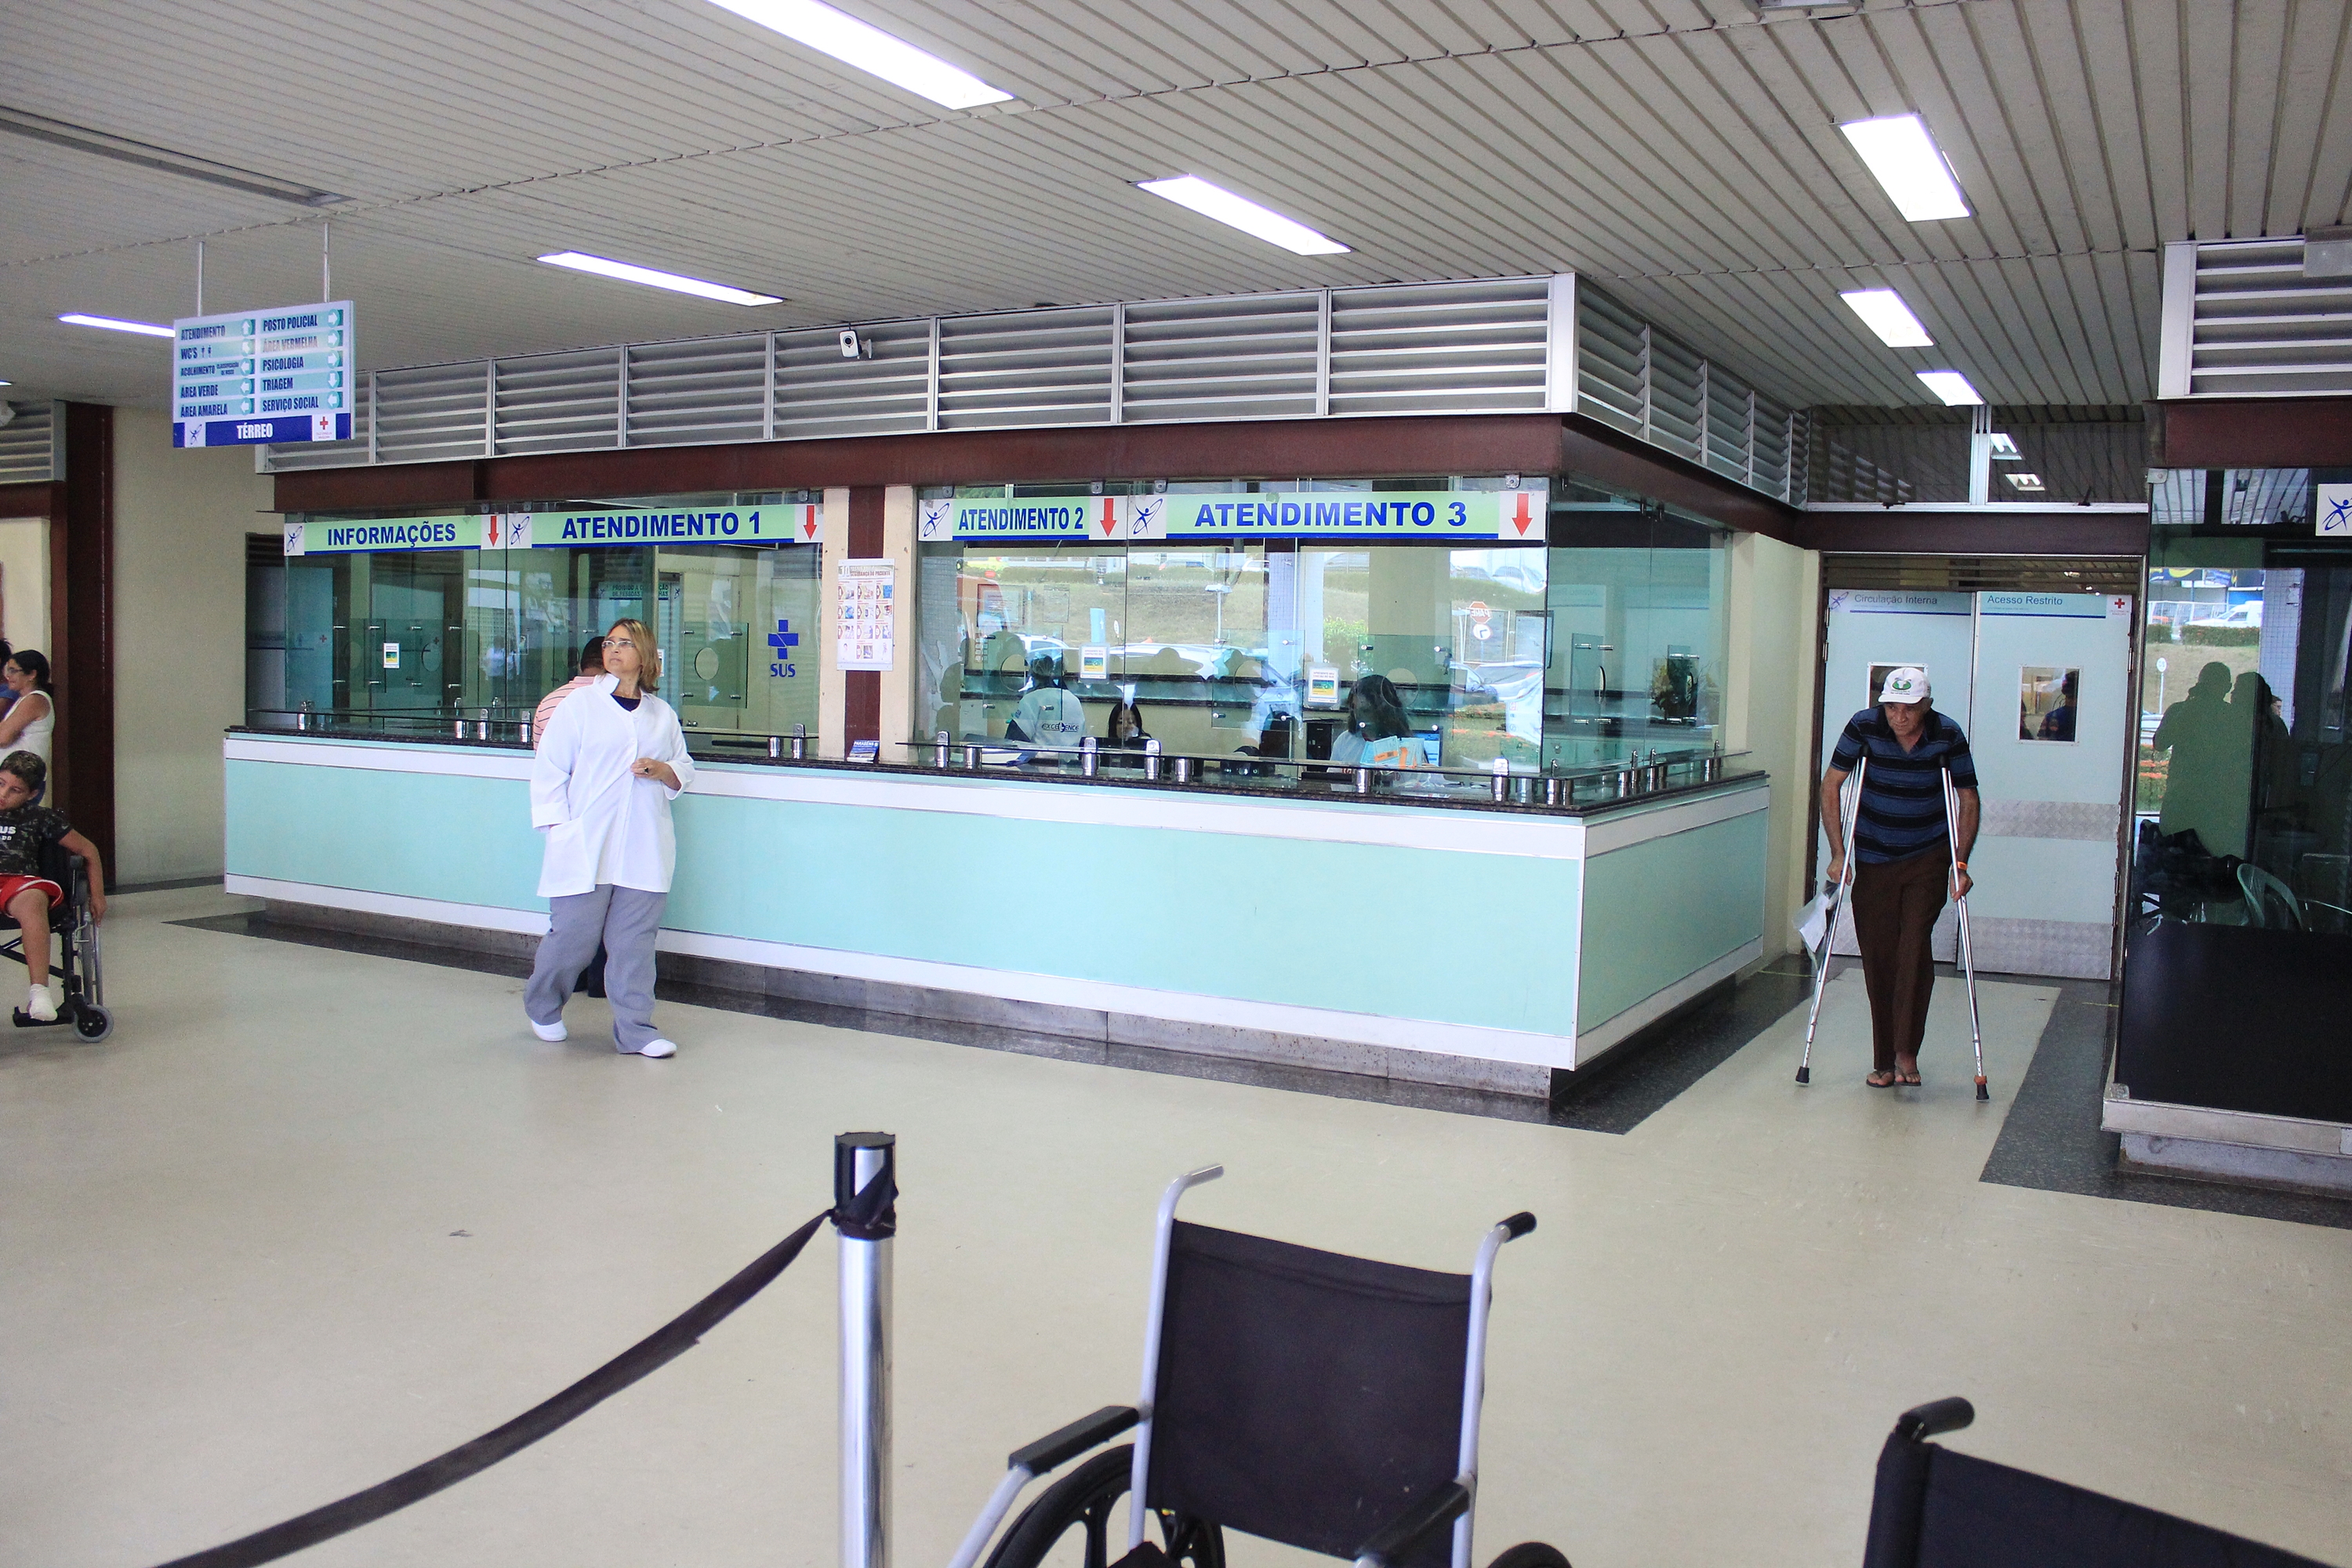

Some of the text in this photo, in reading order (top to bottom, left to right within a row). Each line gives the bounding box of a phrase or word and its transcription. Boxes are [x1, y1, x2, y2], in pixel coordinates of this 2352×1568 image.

[263, 314, 318, 332] POSTO POLICIAL
[181, 325, 226, 340] ATENDIMENTO
[263, 336, 318, 353] ÁREA VERMELHA
[181, 347, 198, 360] WC'S
[181, 365, 216, 376] ACOLHIMENTO
[263, 357, 304, 372] PSICOLOGIA
[180, 384, 219, 398] ÁREA VERDE
[263, 377, 293, 391] TRIAGEM
[180, 404, 228, 418] ÁREA AMARELA
[263, 396, 319, 412] SERVIÇO SOCIAL
[236, 422, 274, 440] TÉRREO
[958, 506, 1083, 531] ATENDIMENTO 2
[1194, 501, 1468, 528] ATENDIMENTO 3
[561, 511, 760, 539] ATENDIMENTO 1
[328, 521, 456, 547] INFORMAÇÕES
[1854, 594, 1937, 605] Circulação Interna
[1987, 595, 2063, 605] Acesso Restrito
[770, 663, 796, 677] SUS
